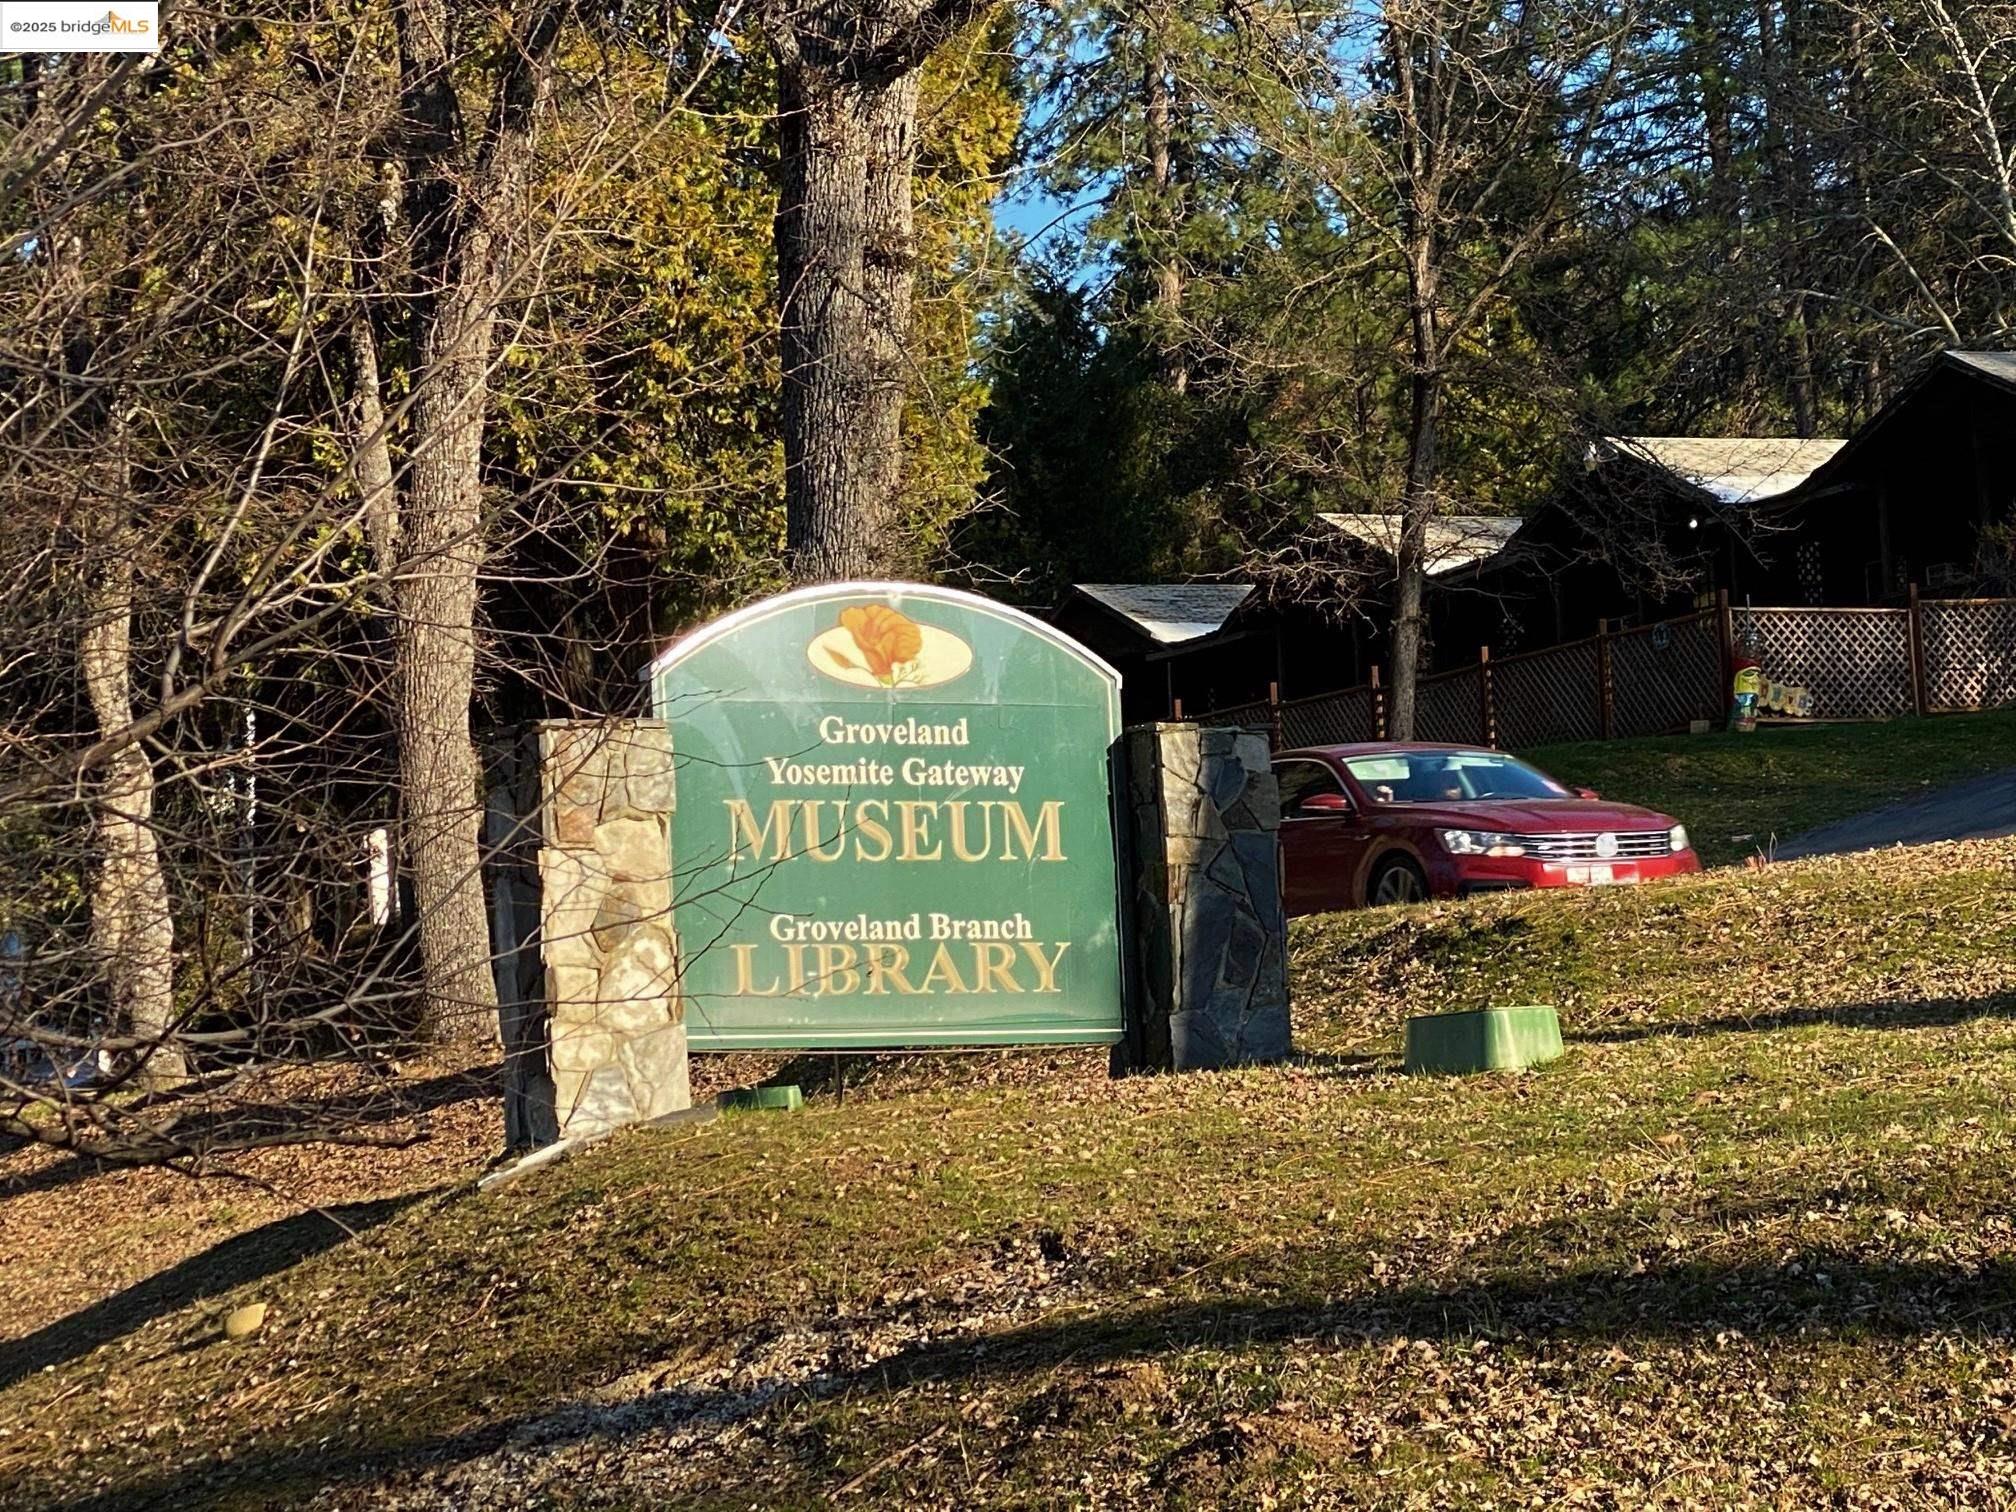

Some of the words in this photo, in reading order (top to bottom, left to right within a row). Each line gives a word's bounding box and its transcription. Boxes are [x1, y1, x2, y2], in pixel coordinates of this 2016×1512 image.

[819, 716, 969, 745] Groveland
[766, 757, 894, 786] Yosemite
[901, 758, 1025, 793] Gateway
[723, 800, 1068, 863] MUSEUM
[769, 914, 922, 941] Groveland
[929, 913, 1033, 940] Branch
[730, 942, 1071, 996] LIBRARY
